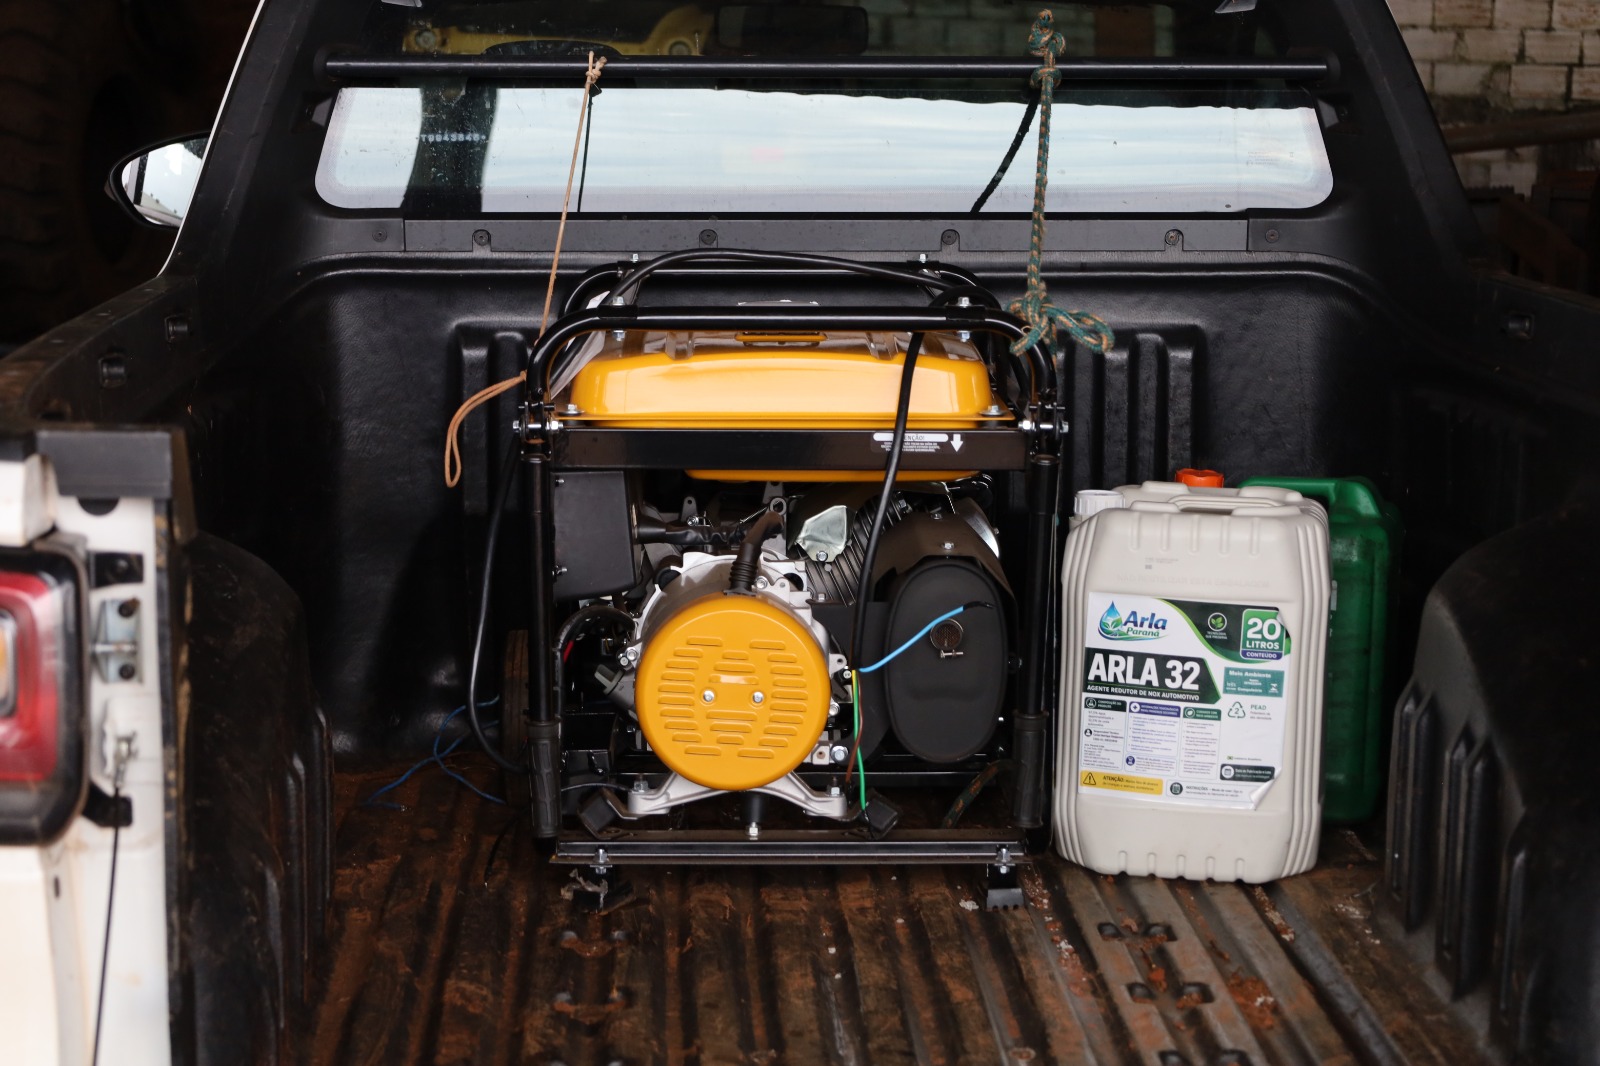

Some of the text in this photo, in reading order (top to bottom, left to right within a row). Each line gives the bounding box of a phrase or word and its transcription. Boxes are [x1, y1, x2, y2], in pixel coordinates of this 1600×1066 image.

[1122, 610, 1168, 630] Arla
[1126, 626, 1160, 638] Paraná
[1246, 618, 1281, 640] 20
[1246, 640, 1280, 650] LITROS
[1088, 652, 1200, 690] ARLA 32
[1087, 685, 1110, 693] AGENTE
[1111, 687, 1138, 695] REDUTOR
[1162, 691, 1199, 700] AUTOMOTIVO
